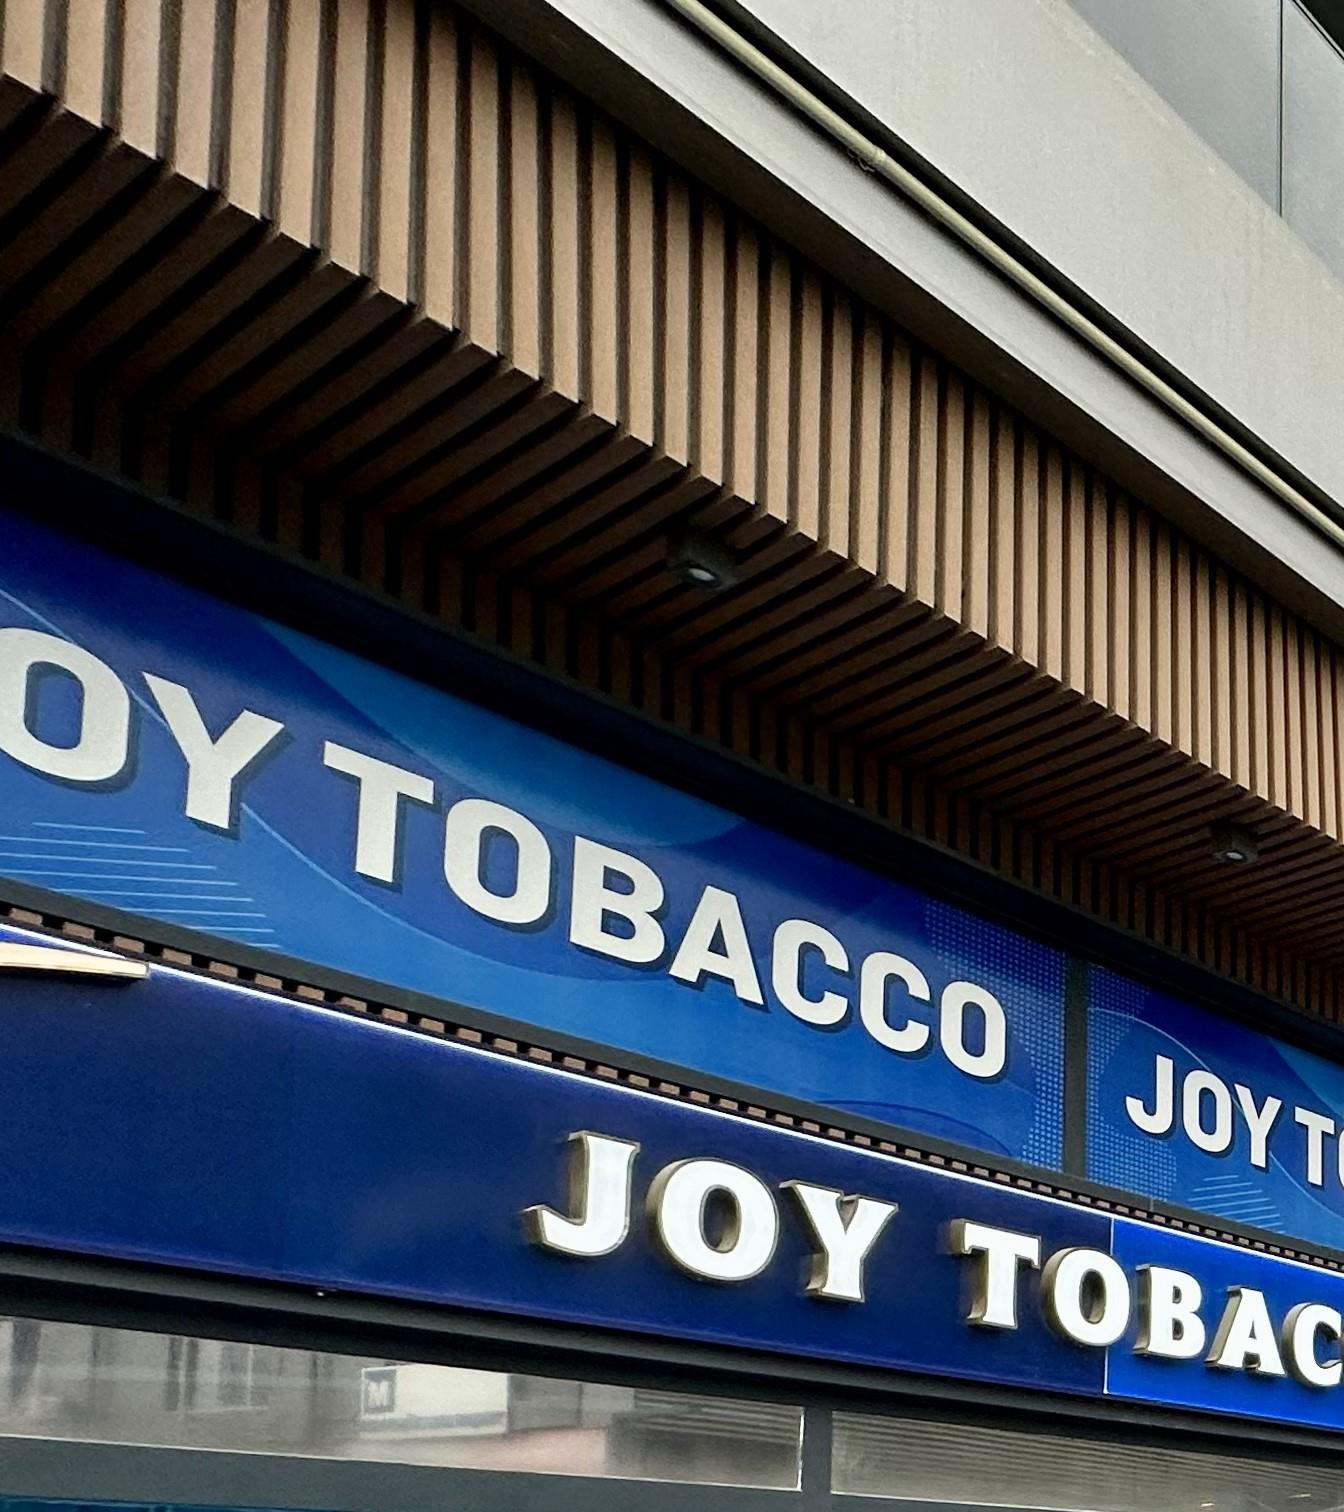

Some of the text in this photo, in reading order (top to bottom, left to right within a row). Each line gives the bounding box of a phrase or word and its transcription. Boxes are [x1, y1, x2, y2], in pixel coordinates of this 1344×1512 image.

[0, 627, 1007, 1080] OY TOBACCO
[1124, 1055, 1282, 1169] JOY
[523, 1130, 899, 1304] JOY
